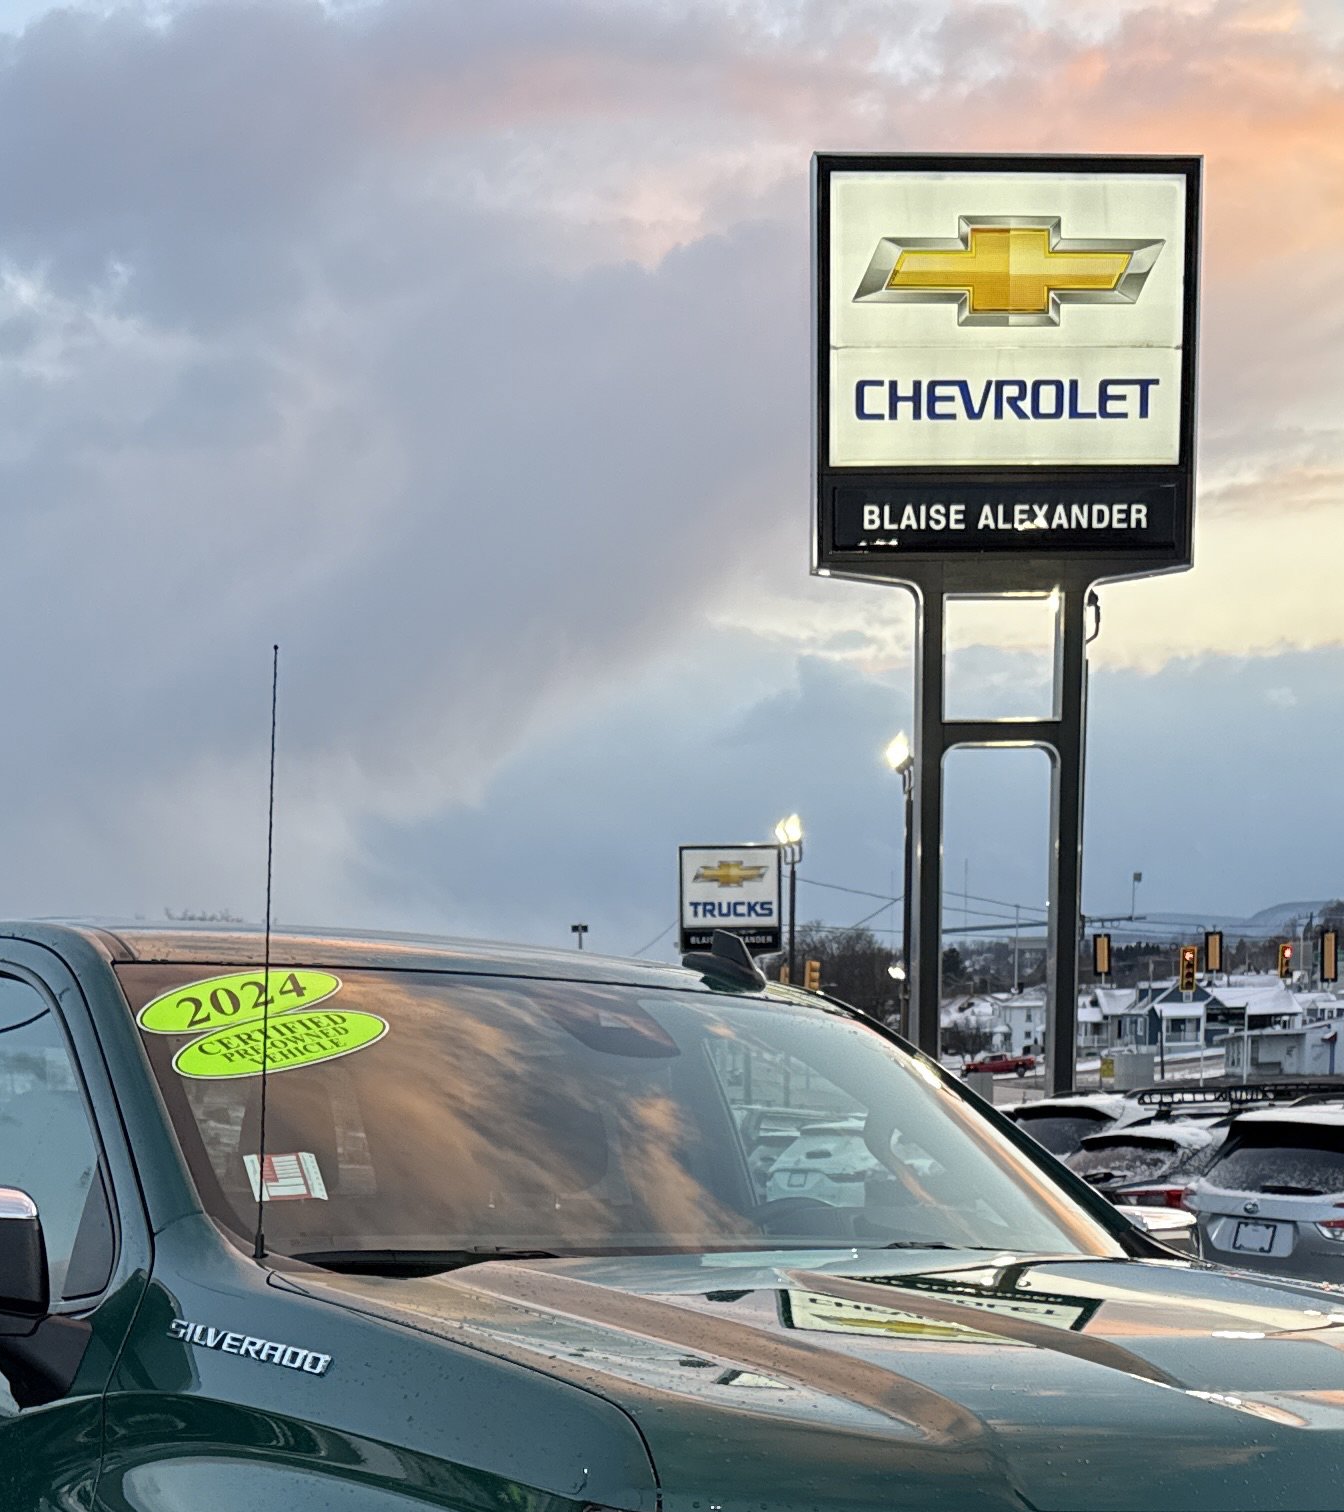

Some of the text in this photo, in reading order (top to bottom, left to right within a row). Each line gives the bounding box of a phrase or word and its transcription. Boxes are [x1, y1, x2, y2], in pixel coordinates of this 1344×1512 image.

[853, 378, 1161, 422] CHEVROLET
[862, 503, 1149, 531] BLAISE ALEXANDER
[689, 901, 773, 918] TRUCKS
[689, 935, 714, 945] BLAIS
[175, 972, 308, 1029] 2024
[197, 1012, 347, 1057] CERTIFIED
[222, 1025, 350, 1064] PRE-OWNED
[248, 1037, 348, 1066] VEHICLE
[166, 1318, 333, 1376] SILVERADO
